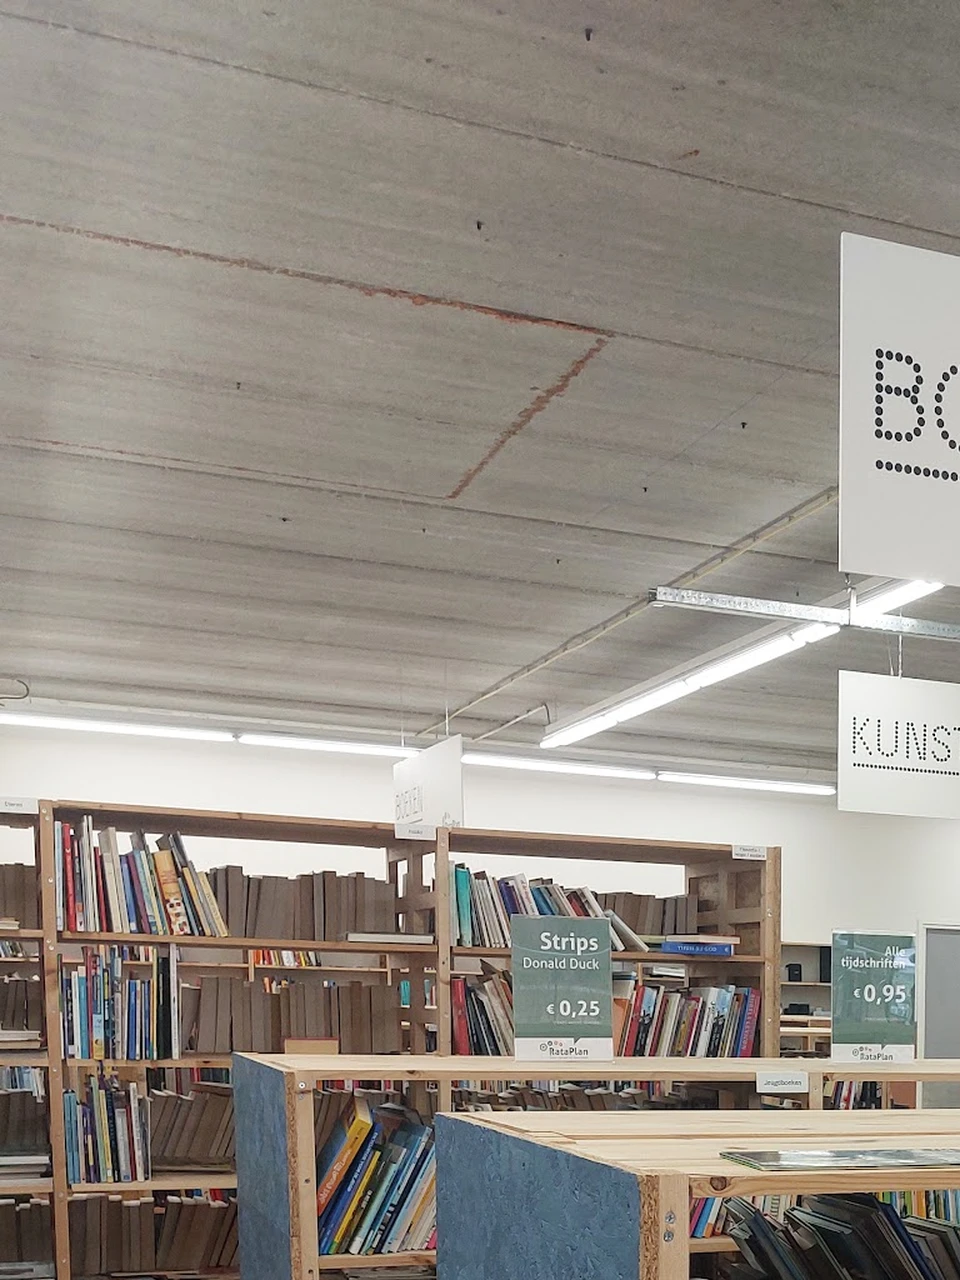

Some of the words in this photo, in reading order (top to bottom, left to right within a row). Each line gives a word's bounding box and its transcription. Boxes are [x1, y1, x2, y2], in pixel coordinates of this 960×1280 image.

[540, 932, 599, 955] Strips
[885, 946, 906, 957] Alle
[523, 957, 566, 969] Donald
[569, 958, 600, 970] Duck
[841, 957, 906, 969] tijdschriften
[864, 984, 906, 1005] 0,95
[559, 1000, 600, 1018] 0,25
[549, 1047, 588, 1056] RataPlan
